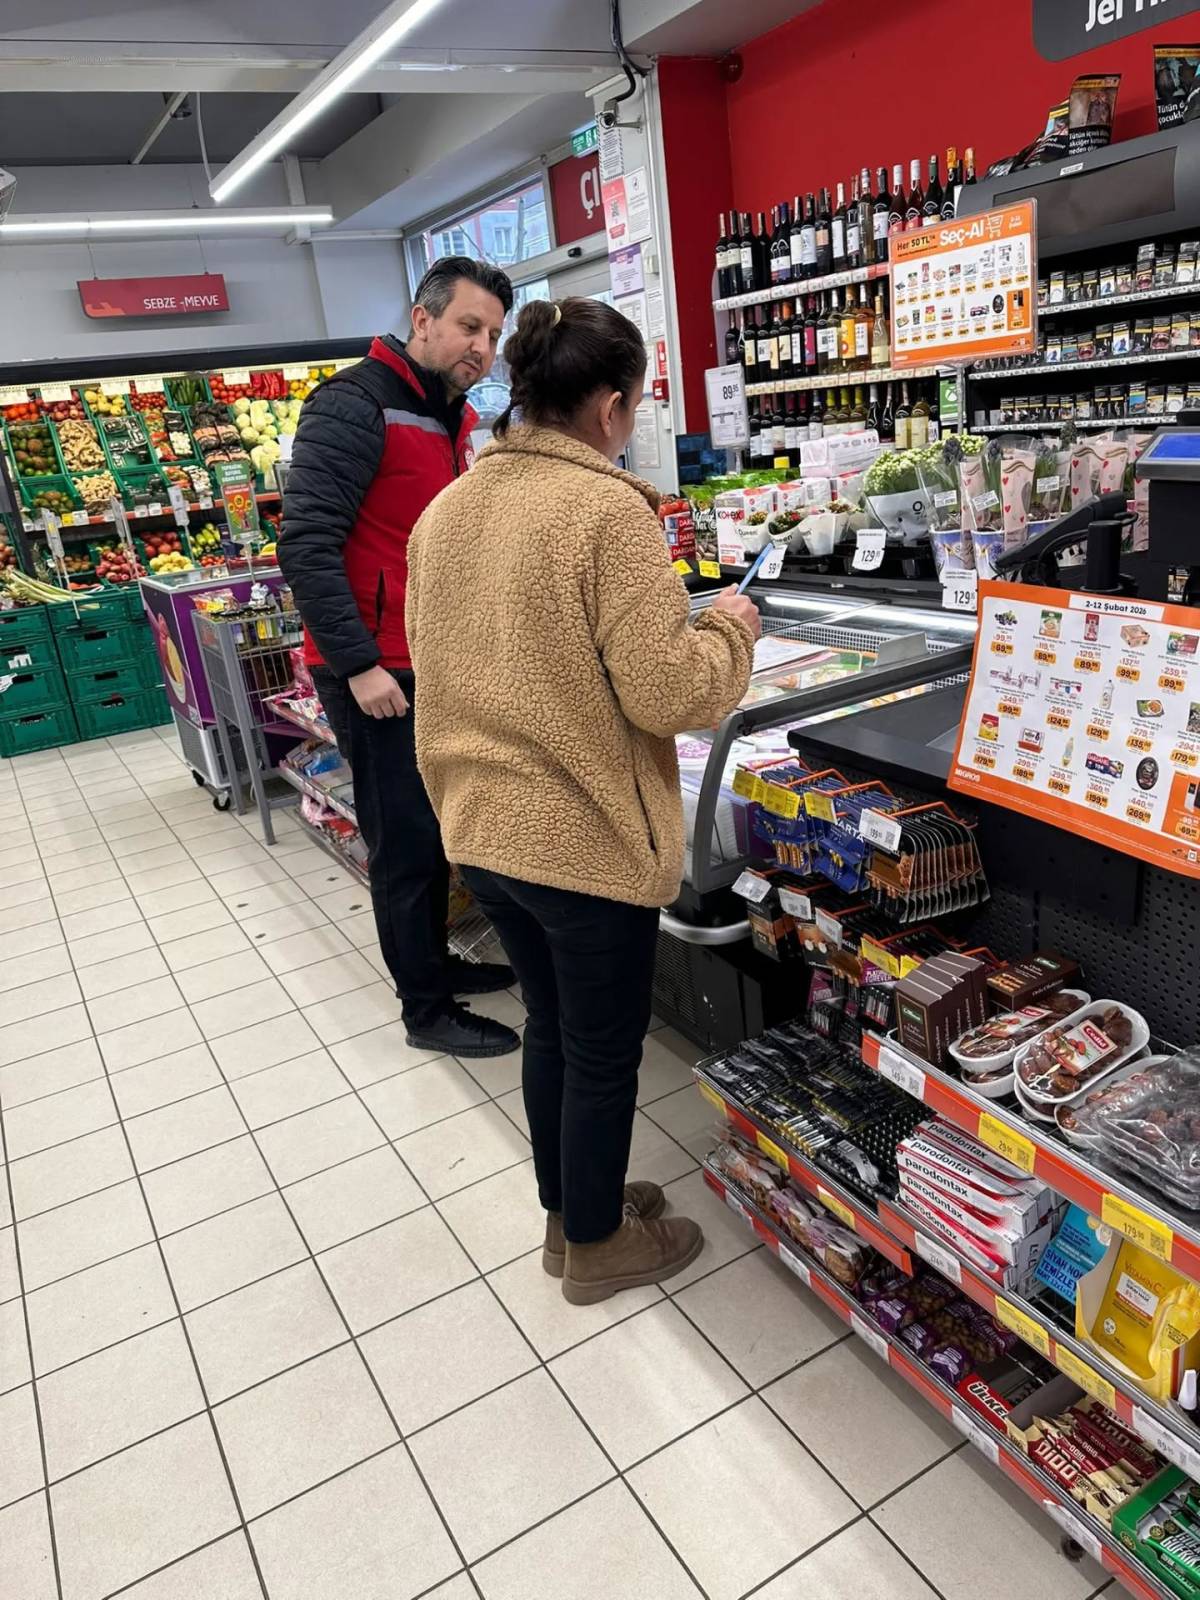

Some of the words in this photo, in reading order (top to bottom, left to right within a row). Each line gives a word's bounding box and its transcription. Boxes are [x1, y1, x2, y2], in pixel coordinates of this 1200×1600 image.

[1158, 113, 1185, 125] çocukl
[580, 167, 601, 219] ÇI
[939, 219, 985, 248] Seç-Al
[143, 296, 177, 310] SEBZE
[1085, 599, 1102, 610] 2-12
[1103, 602, 1128, 613] Şubat
[1129, 605, 1148, 616] 2026
[910, 1140, 973, 1177] parodontax
[927, 1122, 988, 1159] parodontax
[904, 1157, 969, 1198] parodontax
[906, 1176, 964, 1221] parodontax
[968, 1381, 1009, 1419] ÜLKE
